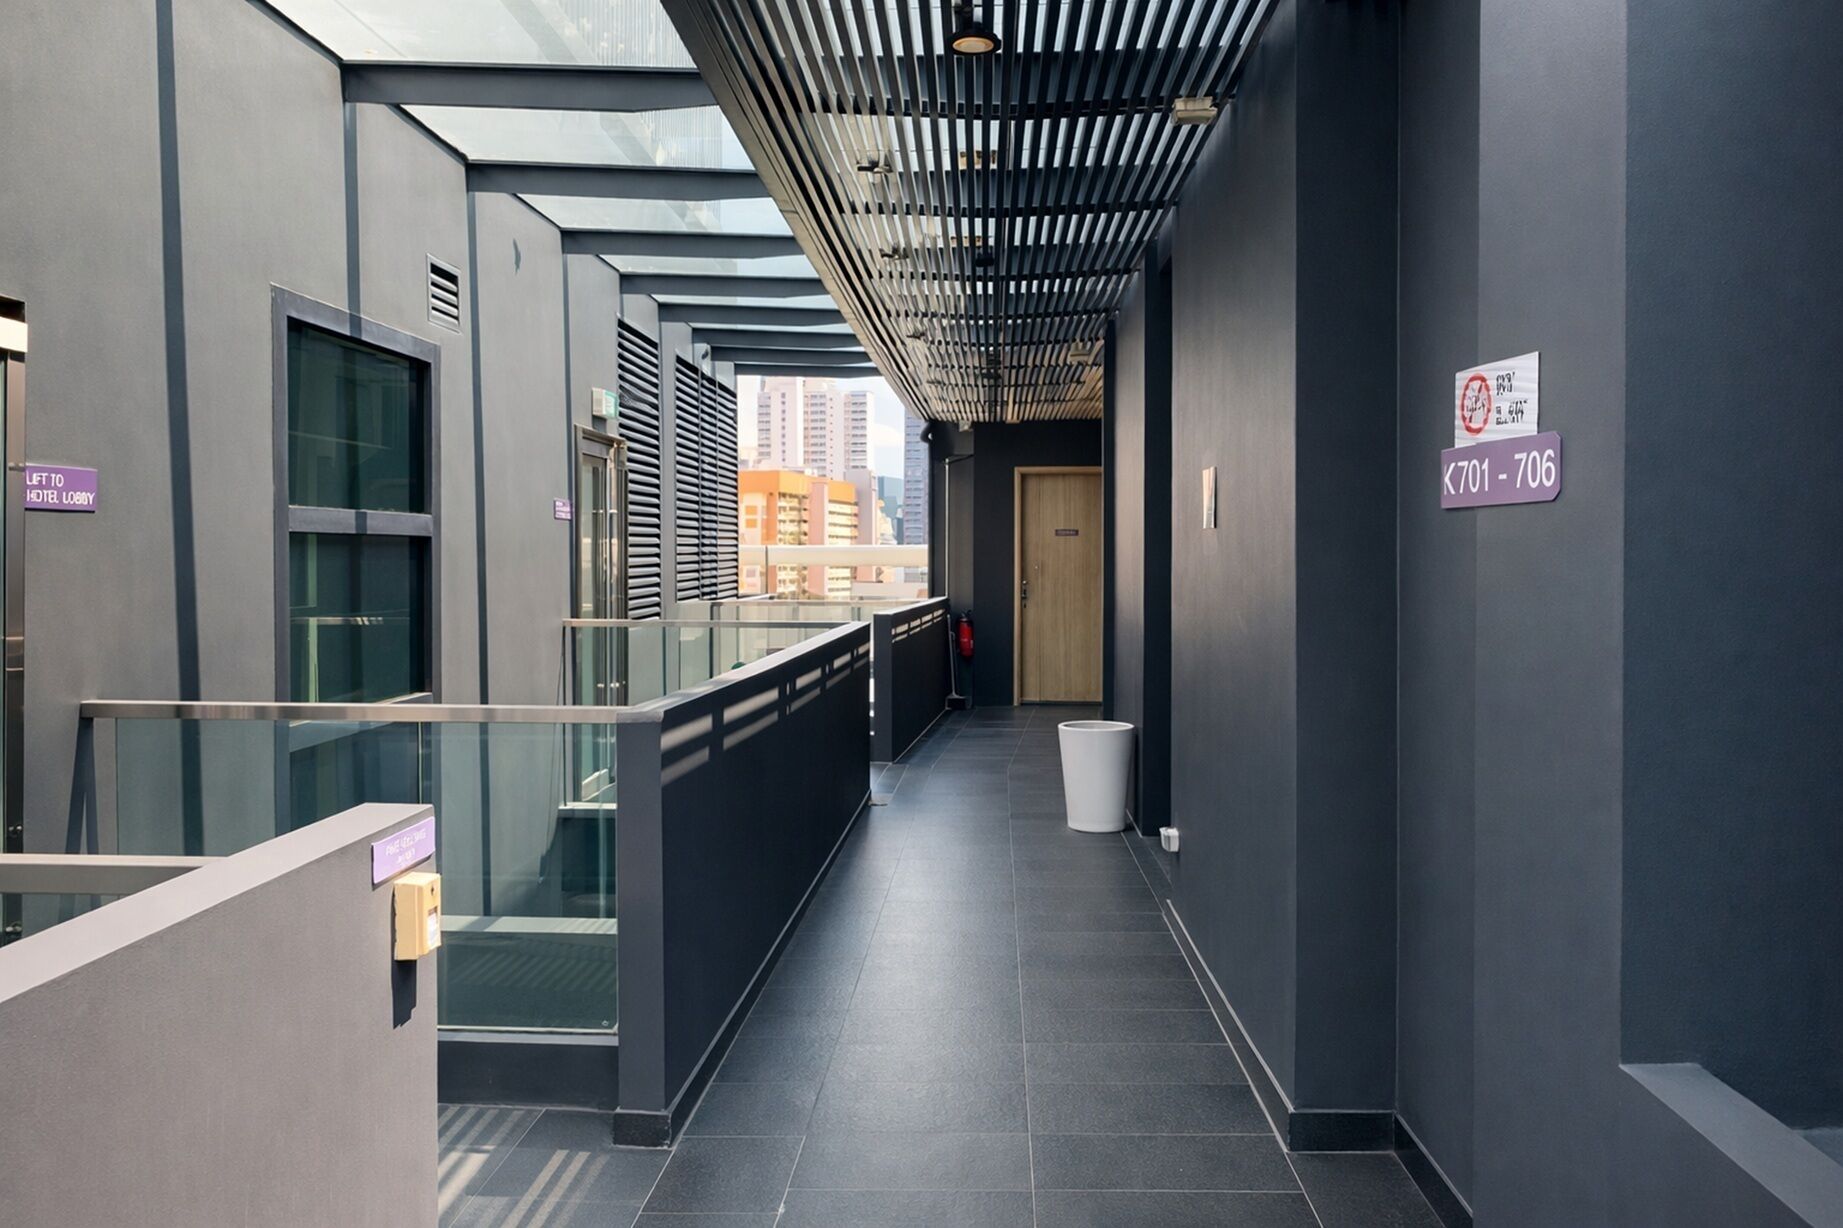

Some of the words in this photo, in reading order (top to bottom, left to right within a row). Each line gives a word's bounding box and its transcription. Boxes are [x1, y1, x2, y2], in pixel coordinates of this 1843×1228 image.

[1443, 458, 1489, 495] K701
[1514, 449, 1556, 488] 706
[50, 473, 65, 487] TO
[62, 491, 96, 505] LOBBY
